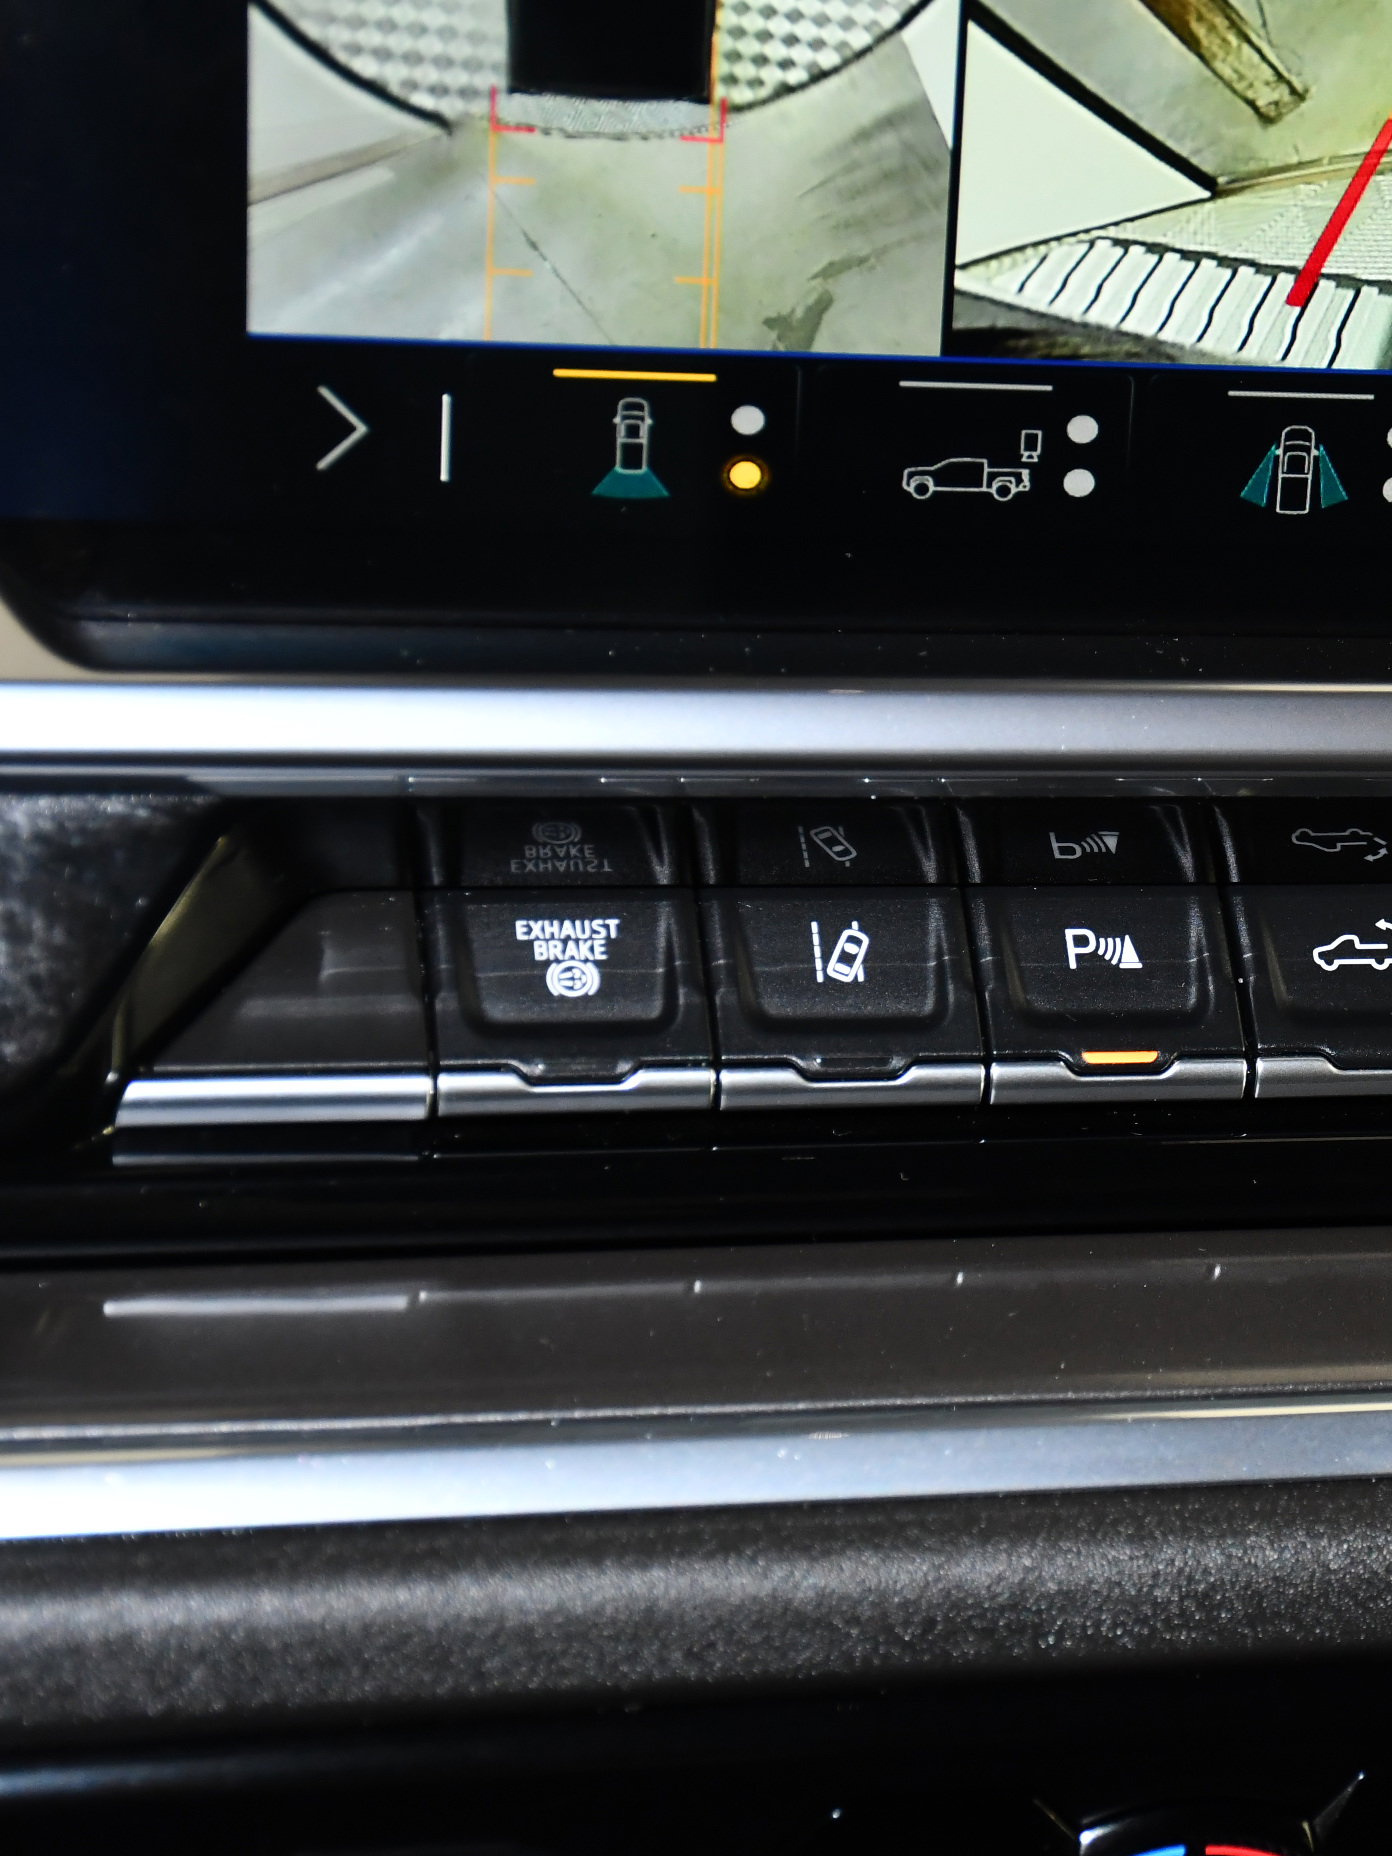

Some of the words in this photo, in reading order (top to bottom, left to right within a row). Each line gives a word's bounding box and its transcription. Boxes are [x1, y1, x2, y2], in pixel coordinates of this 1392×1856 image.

[515, 918, 620, 940] EXHAUST
[533, 939, 608, 961] BRAKE
[1064, 928, 1097, 970] P
